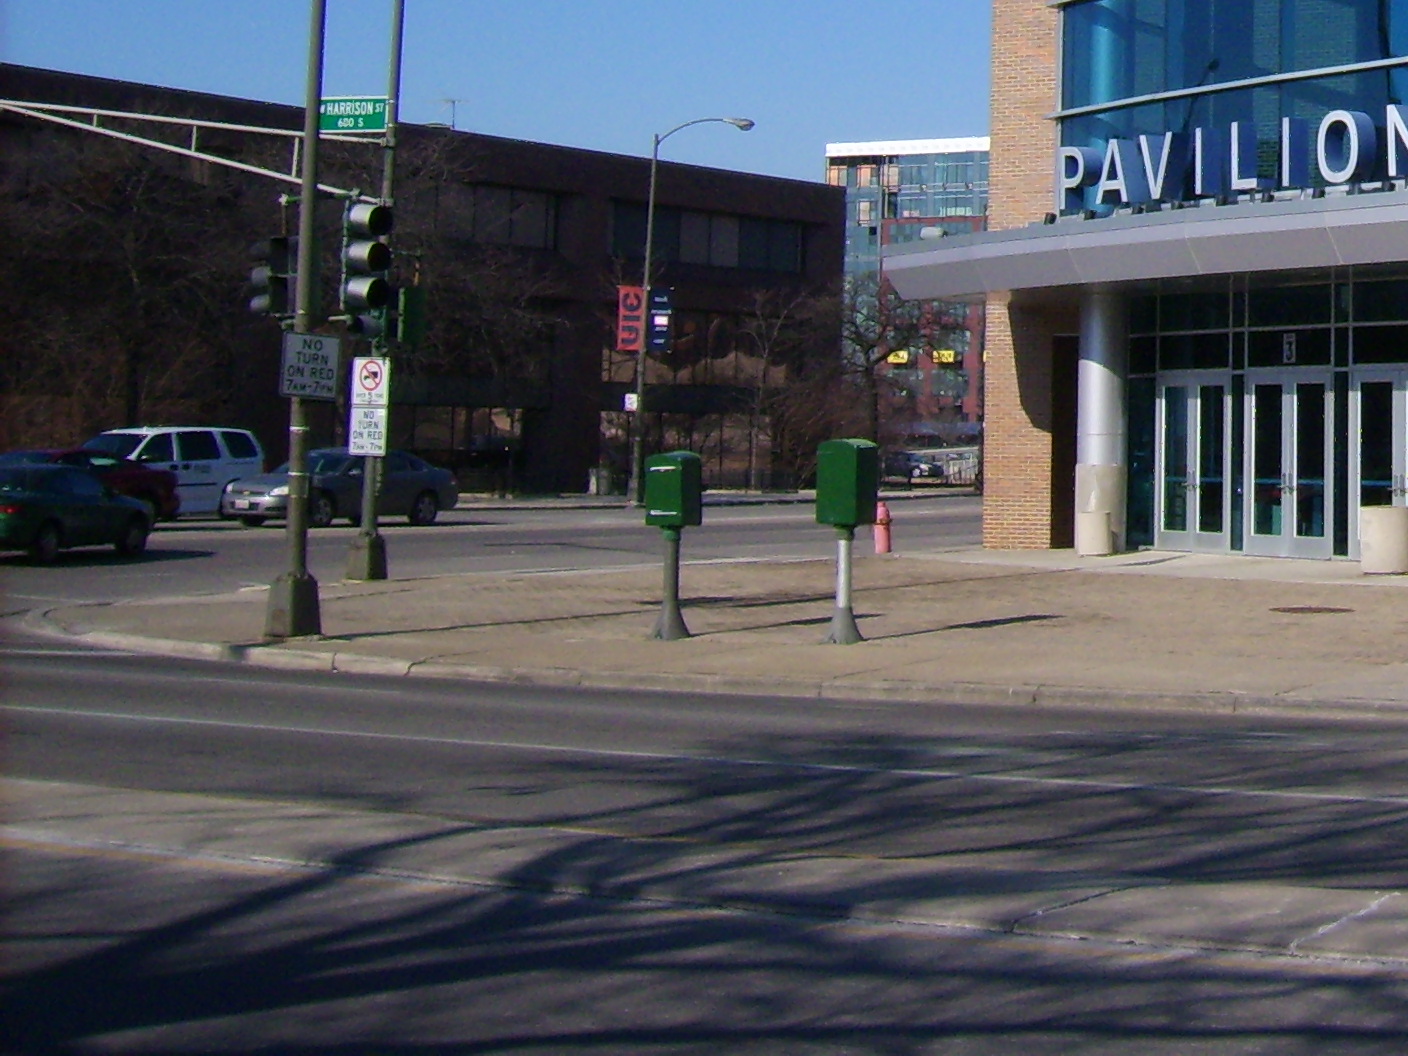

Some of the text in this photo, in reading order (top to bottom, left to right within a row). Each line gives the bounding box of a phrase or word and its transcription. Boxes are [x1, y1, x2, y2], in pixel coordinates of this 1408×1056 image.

[326, 102, 374, 116] HARRISON
[375, 103, 384, 113] ST
[358, 118, 364, 128] S
[621, 292, 642, 346] UIC
[303, 338, 323, 351] NO
[296, 351, 329, 366] TURN
[287, 364, 335, 381] ON RED
[363, 410, 375, 420] NO
[358, 420, 380, 430] TURN
[352, 430, 384, 441] ON RED
